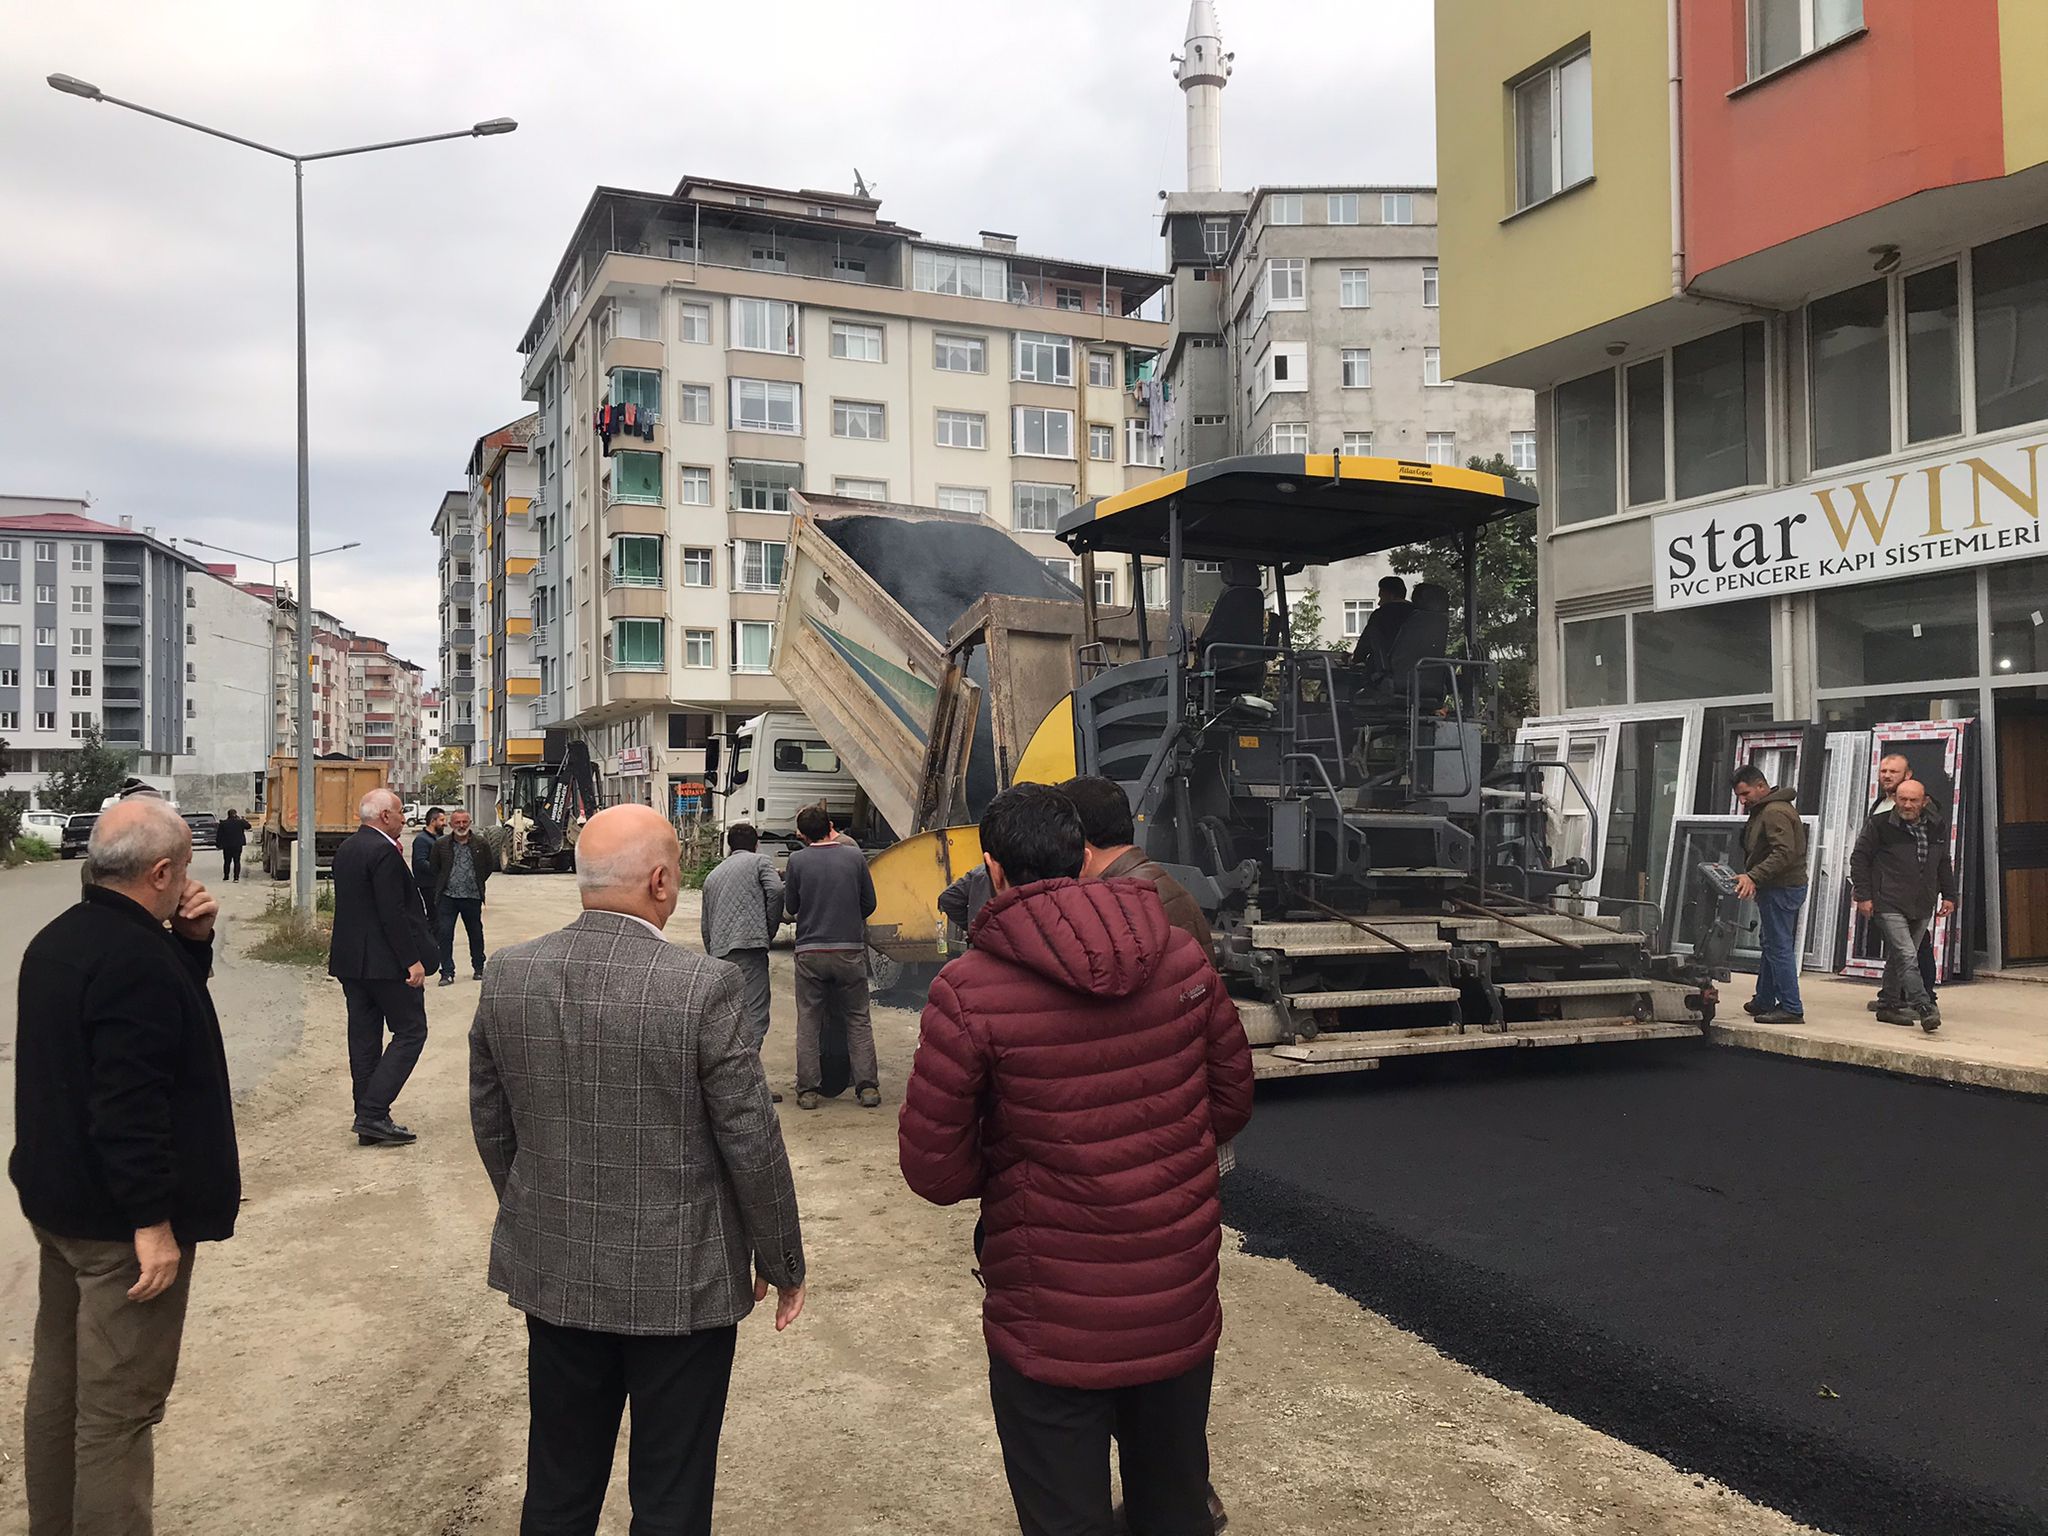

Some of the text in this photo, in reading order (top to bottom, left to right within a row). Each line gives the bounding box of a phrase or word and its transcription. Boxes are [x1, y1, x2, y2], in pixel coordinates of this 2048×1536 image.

[1670, 520, 2041, 599] PVC PENCERE KAPI SİSTEMLERİ
